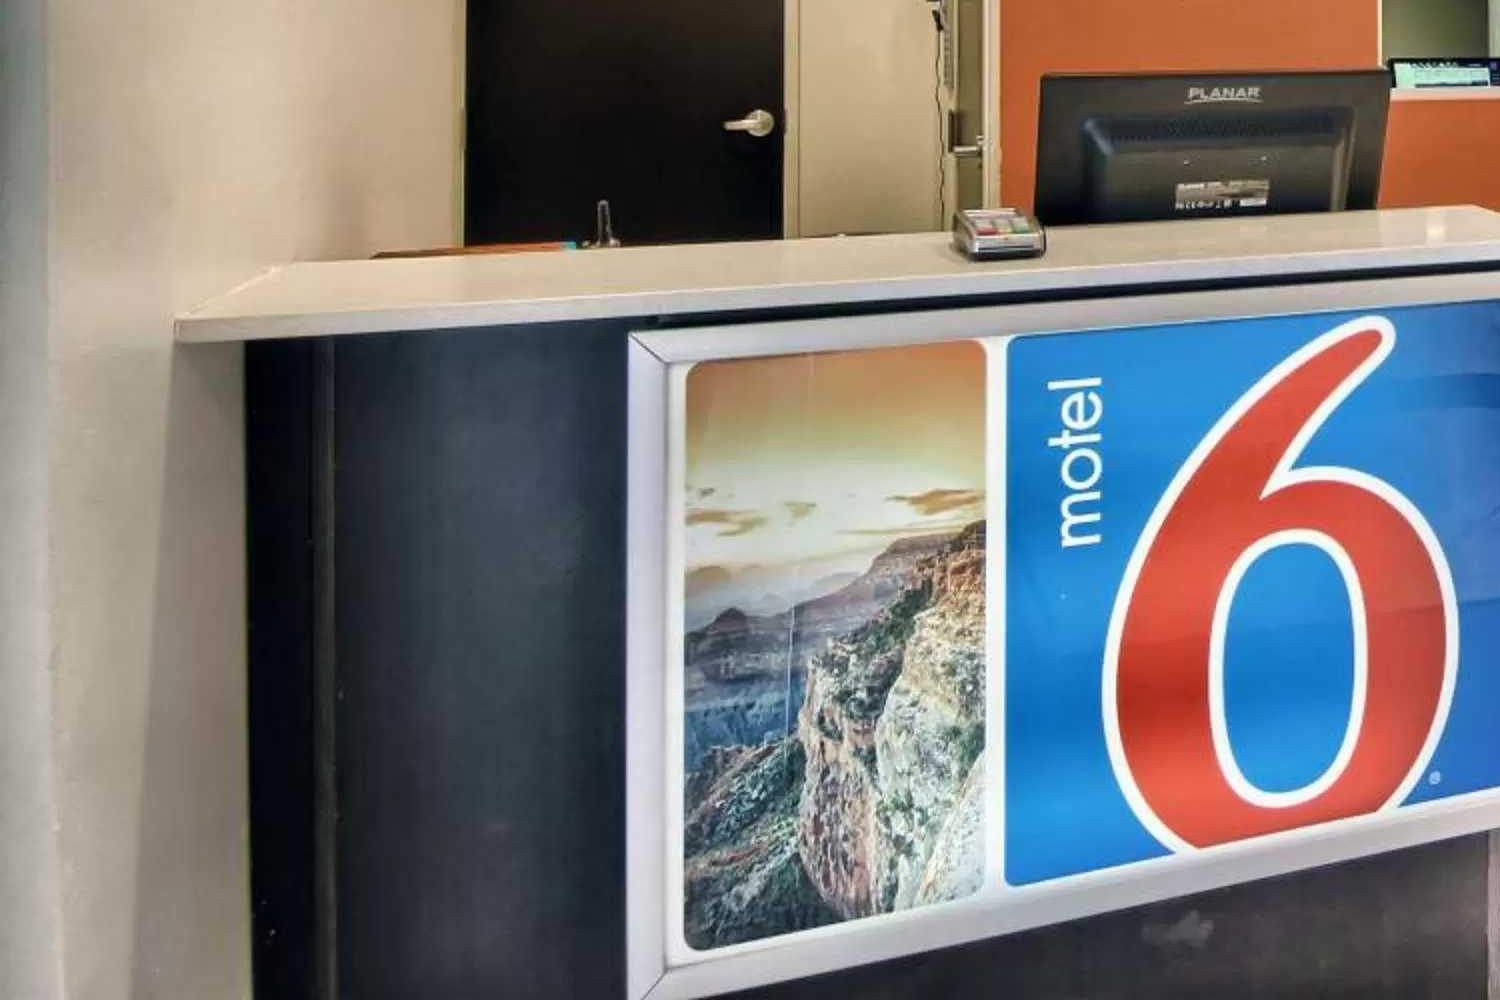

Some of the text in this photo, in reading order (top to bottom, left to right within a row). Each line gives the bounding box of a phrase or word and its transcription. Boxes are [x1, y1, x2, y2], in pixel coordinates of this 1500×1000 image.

[1187, 86, 1261, 99] PLANAR
[1047, 376, 1102, 548] motel
[1101, 315, 1460, 852] 6
